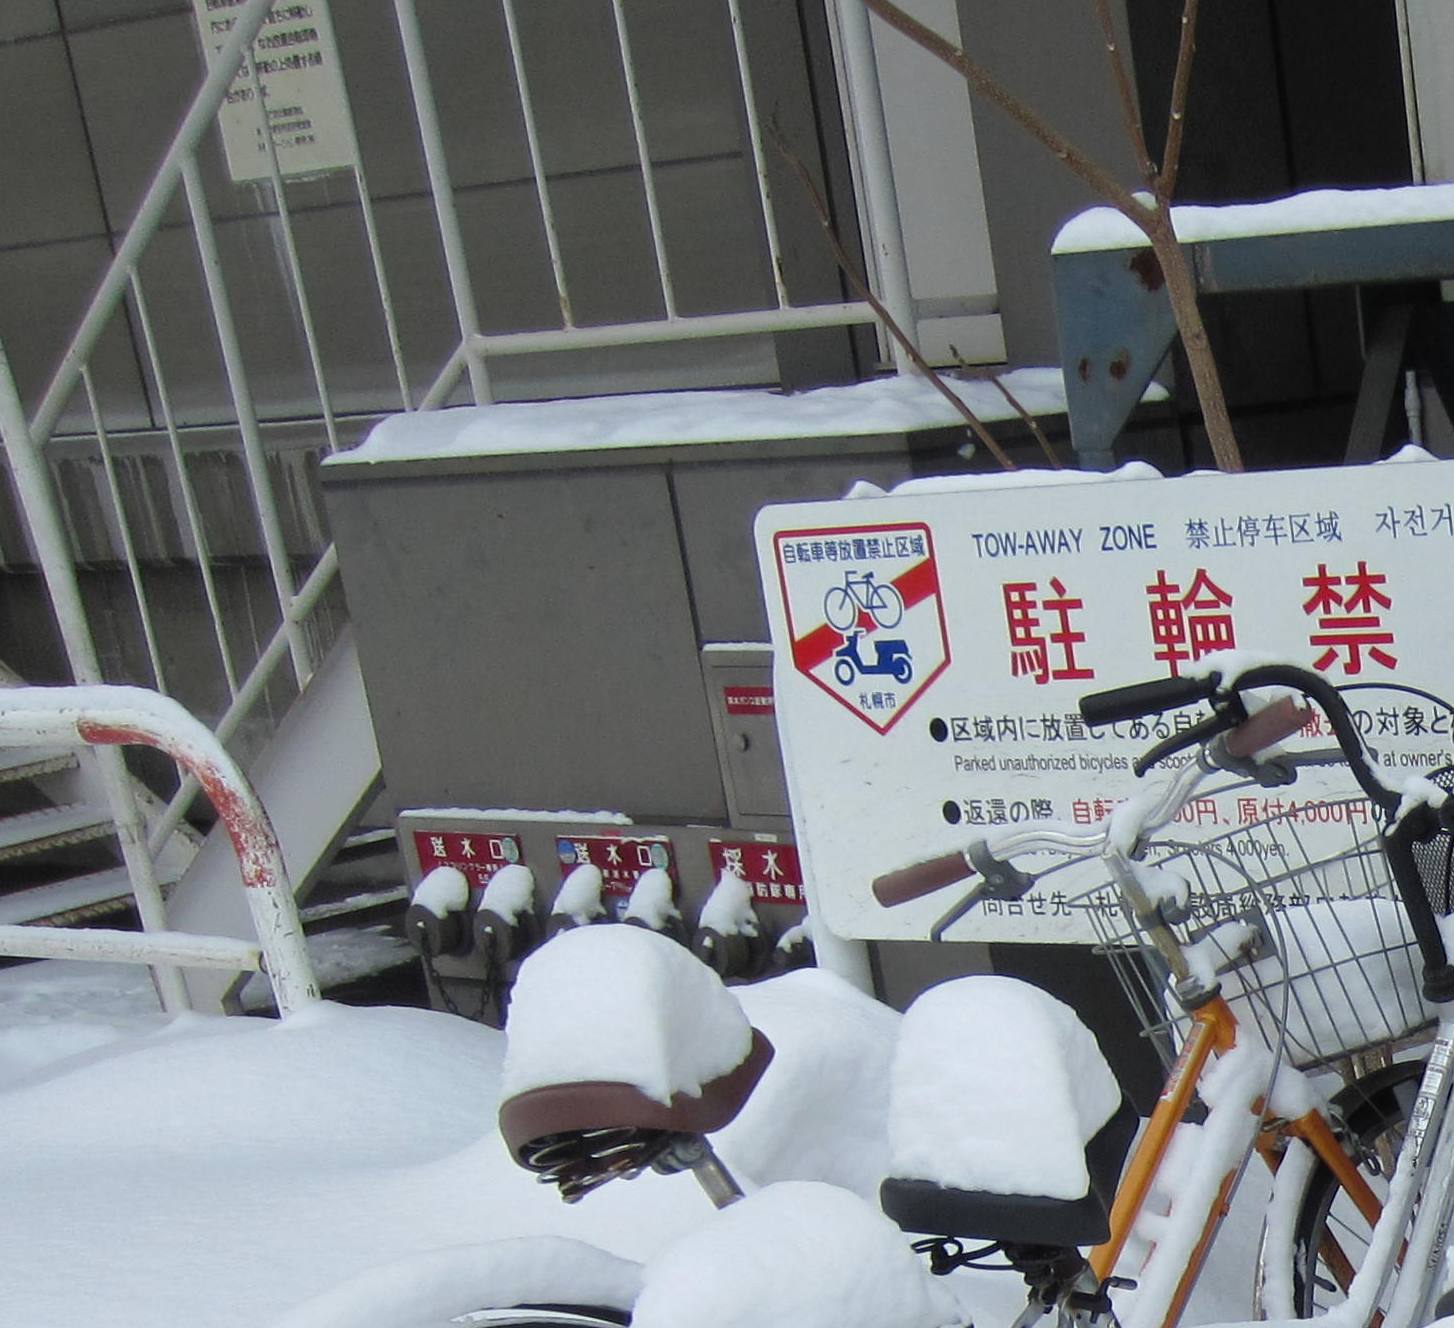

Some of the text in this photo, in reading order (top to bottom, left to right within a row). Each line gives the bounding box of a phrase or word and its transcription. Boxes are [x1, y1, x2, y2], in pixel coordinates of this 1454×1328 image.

[1185, 510, 1343, 549] 禁止停车区域
[1375, 504, 1454, 539] 자전거
[783, 535, 926, 564] 自転車等放置禁止区域
[972, 524, 1157, 558] TOW-AWAY ZONE
[859, 691, 897, 710] 札幌市
[954, 754, 996, 772] Parked
[999, 752, 1076, 772] unauthorized
[1079, 752, 1128, 774] bicycles
[1383, 752, 1396, 767] at
[1400, 749, 1453, 767] owner's
[430, 836, 505, 860] 送水口
[574, 842, 653, 867] 送水口
[723, 848, 784, 881] 採水
